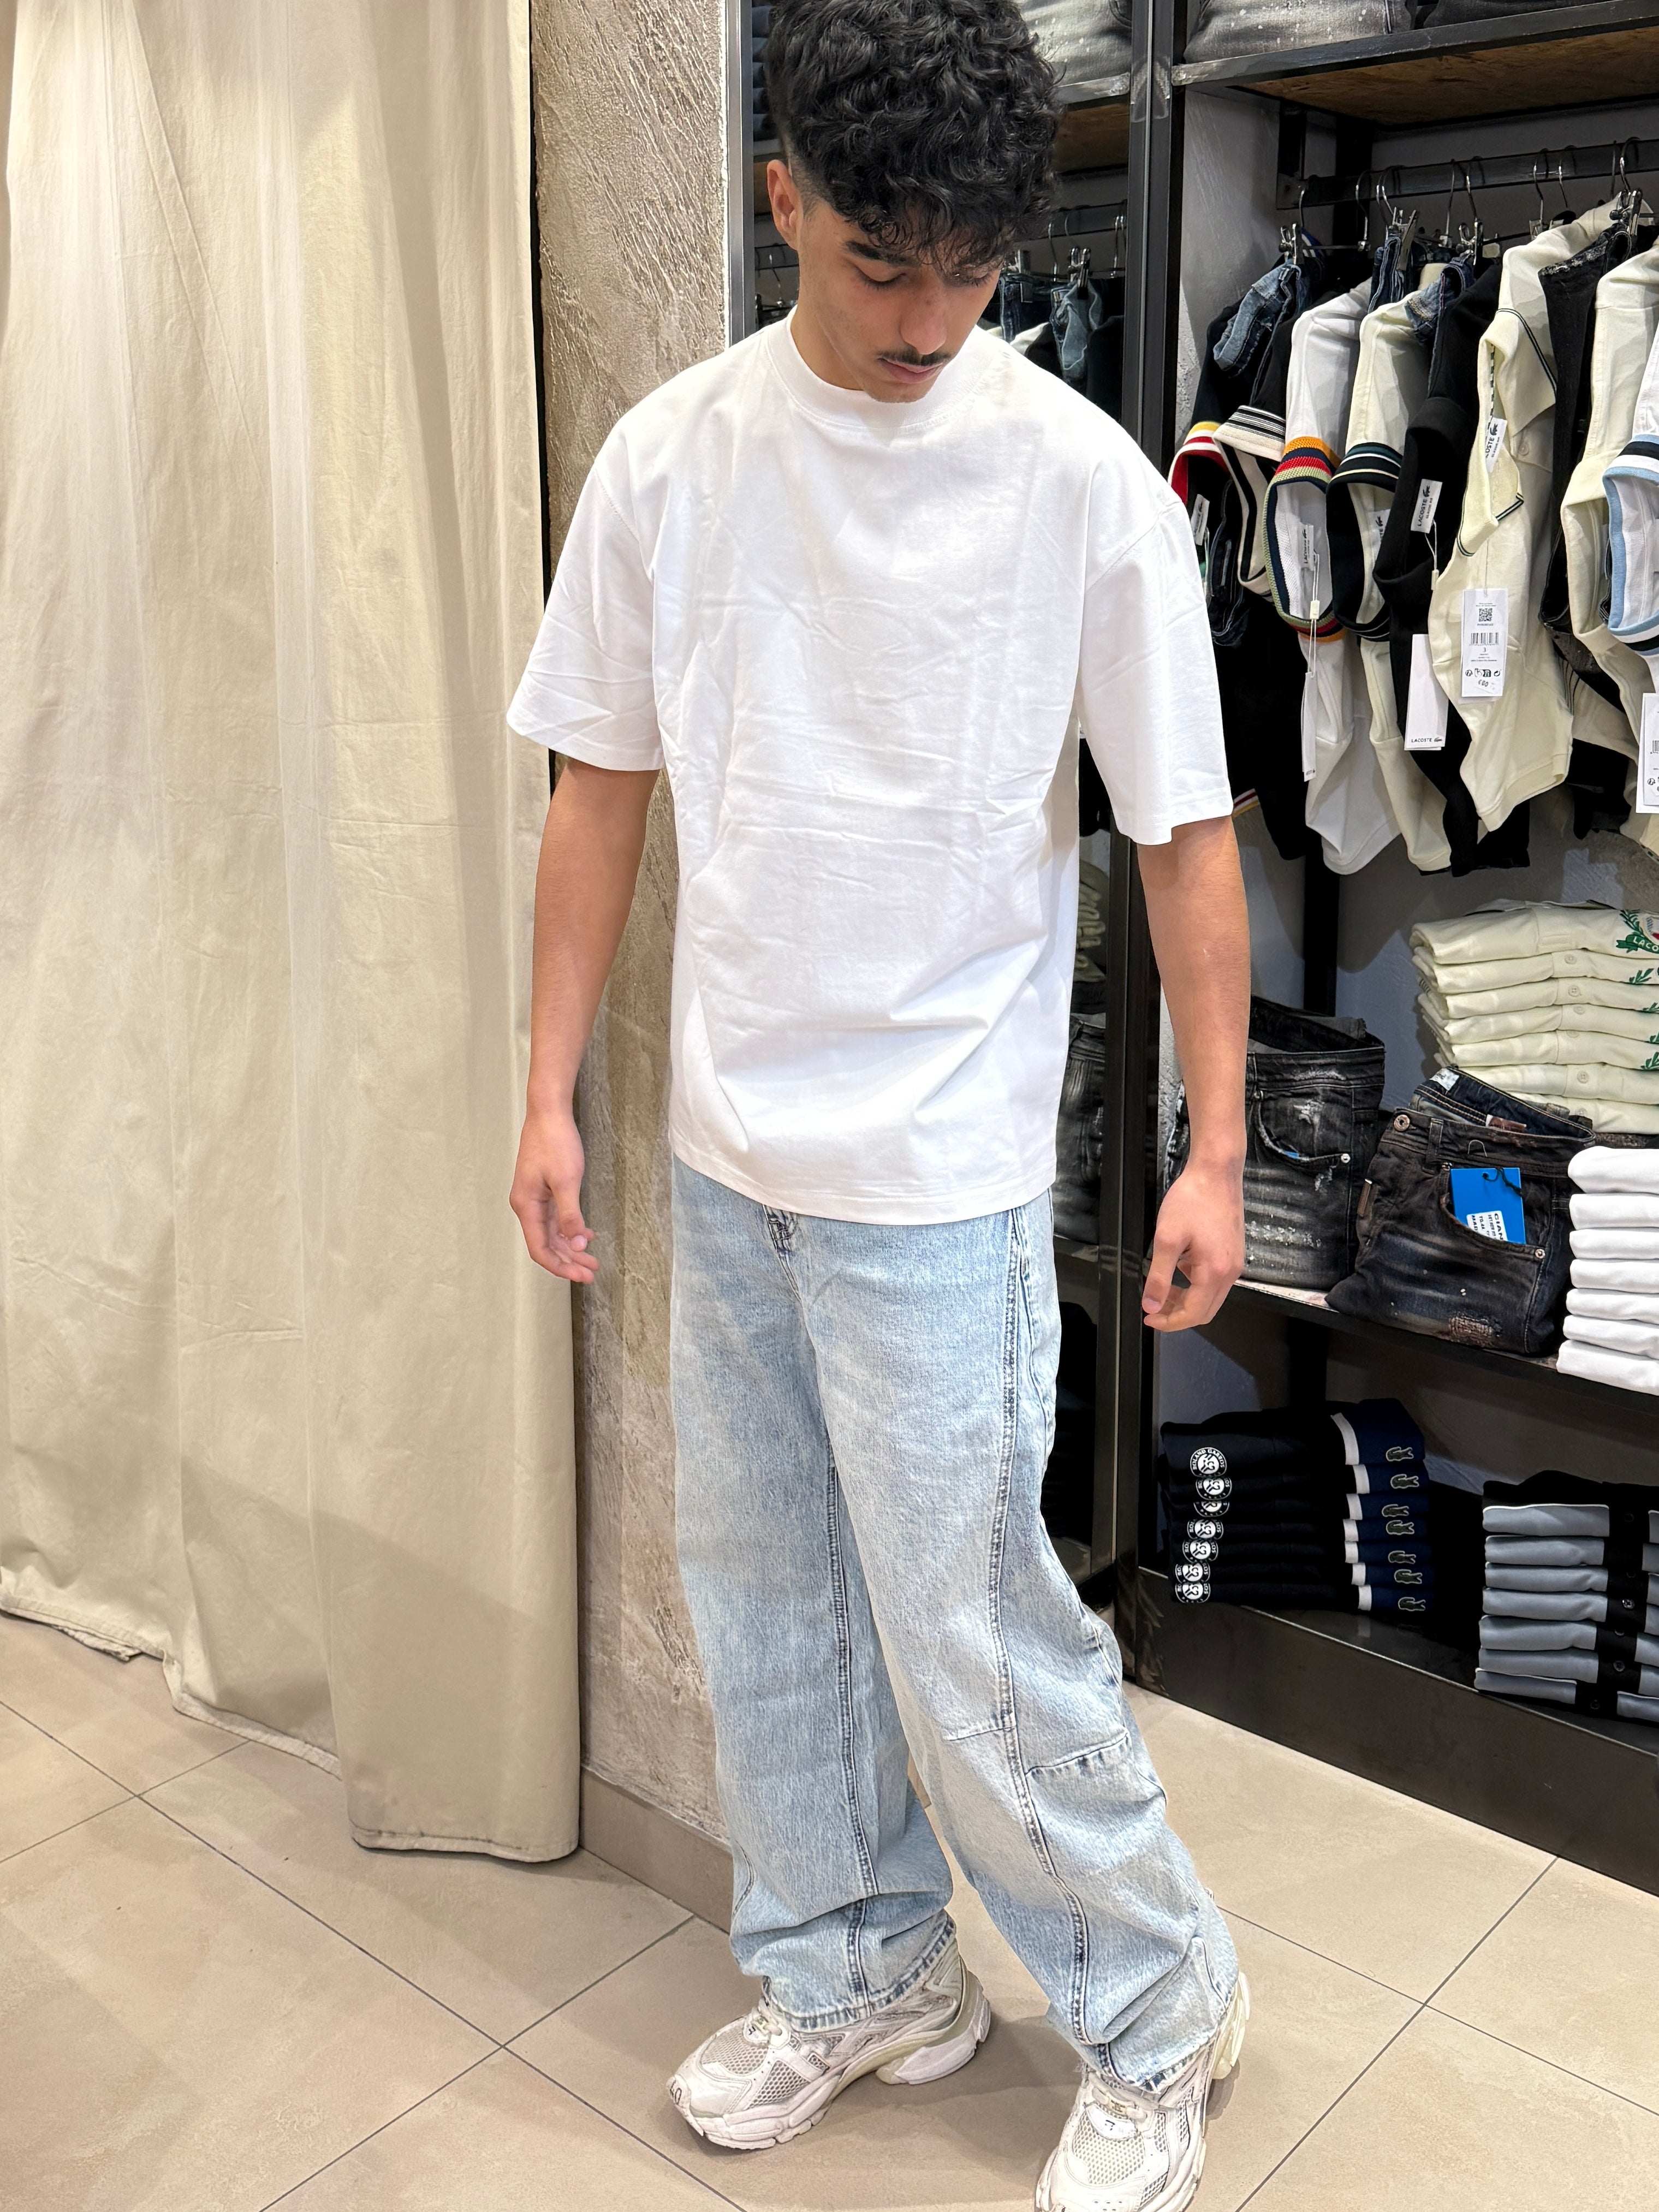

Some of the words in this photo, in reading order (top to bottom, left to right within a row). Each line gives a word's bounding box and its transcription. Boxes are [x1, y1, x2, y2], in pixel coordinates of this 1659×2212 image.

[1418, 499, 1427, 526] LACOSTE
[1192, 1449, 1206, 1470] ROLAND
[1208, 1449, 1224, 1468] GARROS
